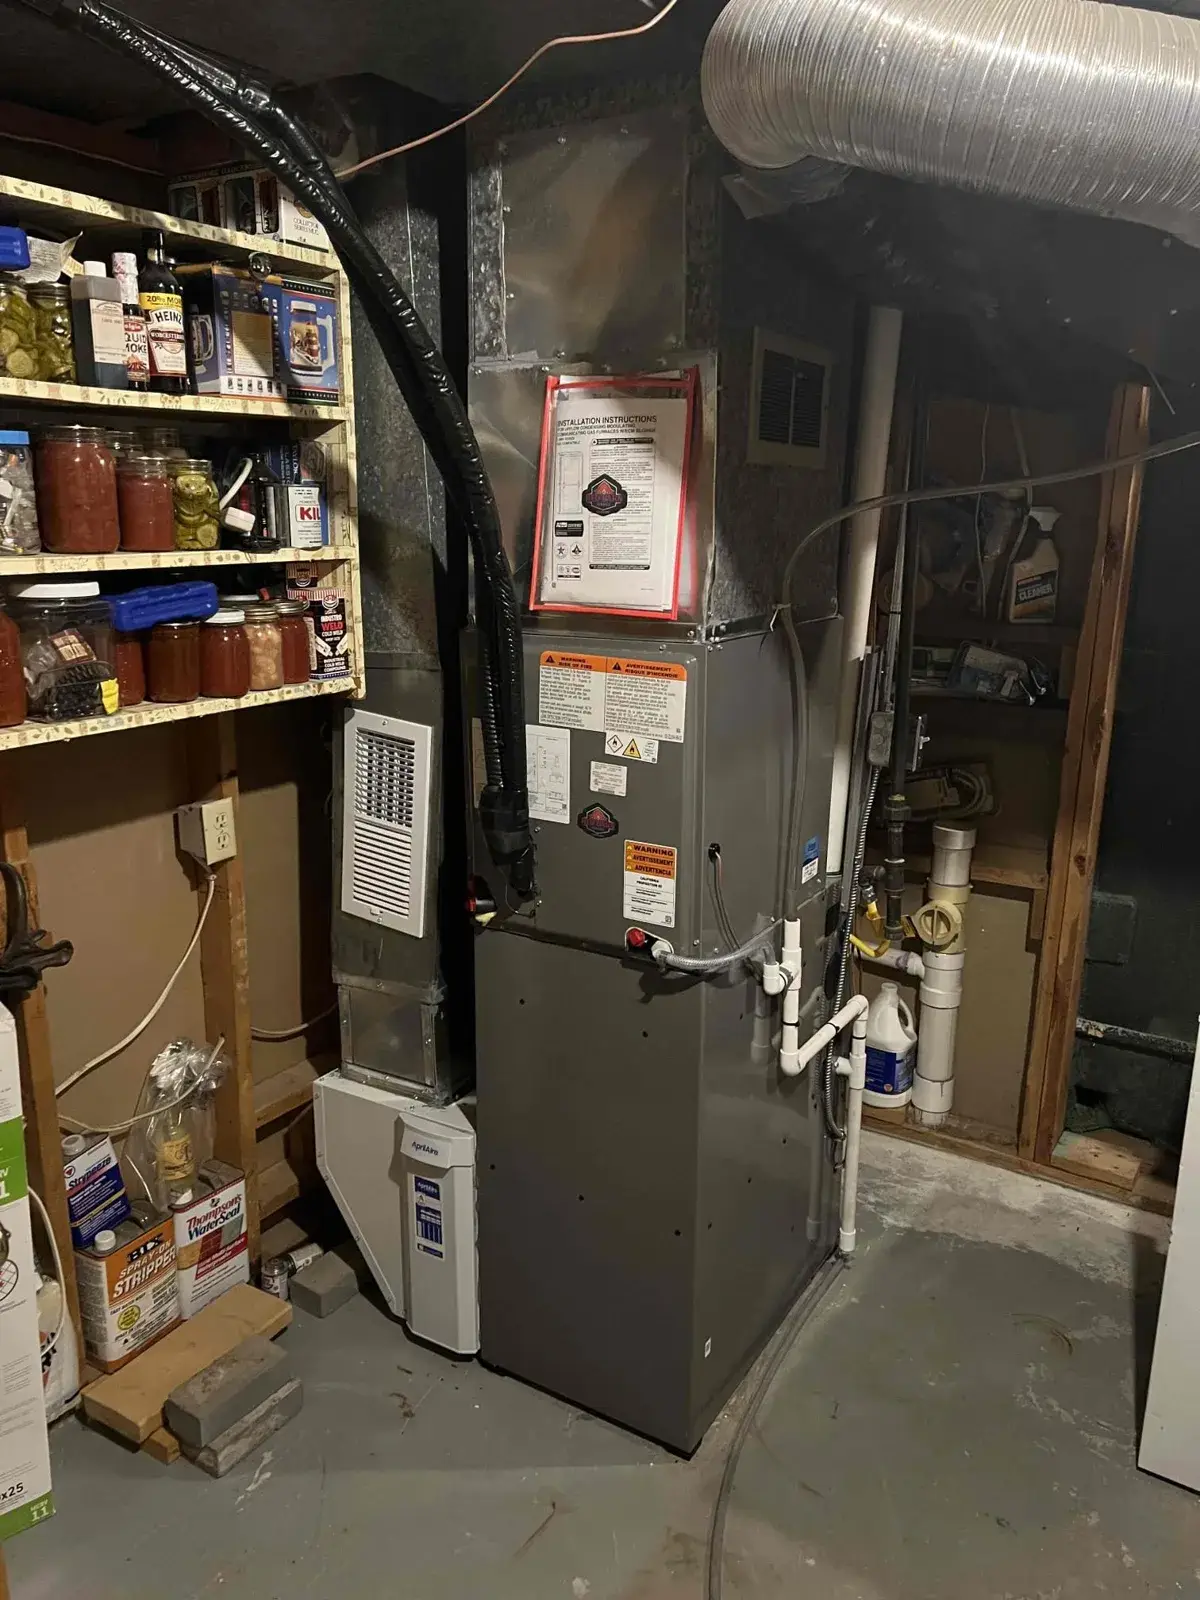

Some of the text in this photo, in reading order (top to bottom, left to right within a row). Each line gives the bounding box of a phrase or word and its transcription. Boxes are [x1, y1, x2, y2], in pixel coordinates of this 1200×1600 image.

[154, 311, 182, 324] HEINZ
[124, 333, 146, 343] QUID
[557, 415, 657, 427] INSTALLATION INSTRUCTIONS
[300, 506, 320, 520] KIL
[321, 622, 344, 631] WELD
[626, 663, 672, 672] AVERTISSEMENT
[646, 670, 678, 679] D'INCENDIE
[633, 845, 674, 857] WARNING
[633, 854, 674, 867] AVERTISSEMENT
[635, 864, 672, 876] ADVERTENCIA
[411, 1141, 439, 1156] AprilAire
[68, 1156, 112, 1187] Strypeeze
[186, 1193, 242, 1230] Thompson's
[188, 1203, 240, 1240] WaterSeal
[120, 1239, 172, 1279] SPRAY-ON
[113, 1245, 177, 1298] STRIPPER
[0, 1482, 24, 1500] x25
[32, 1506, 49, 1521] 11
